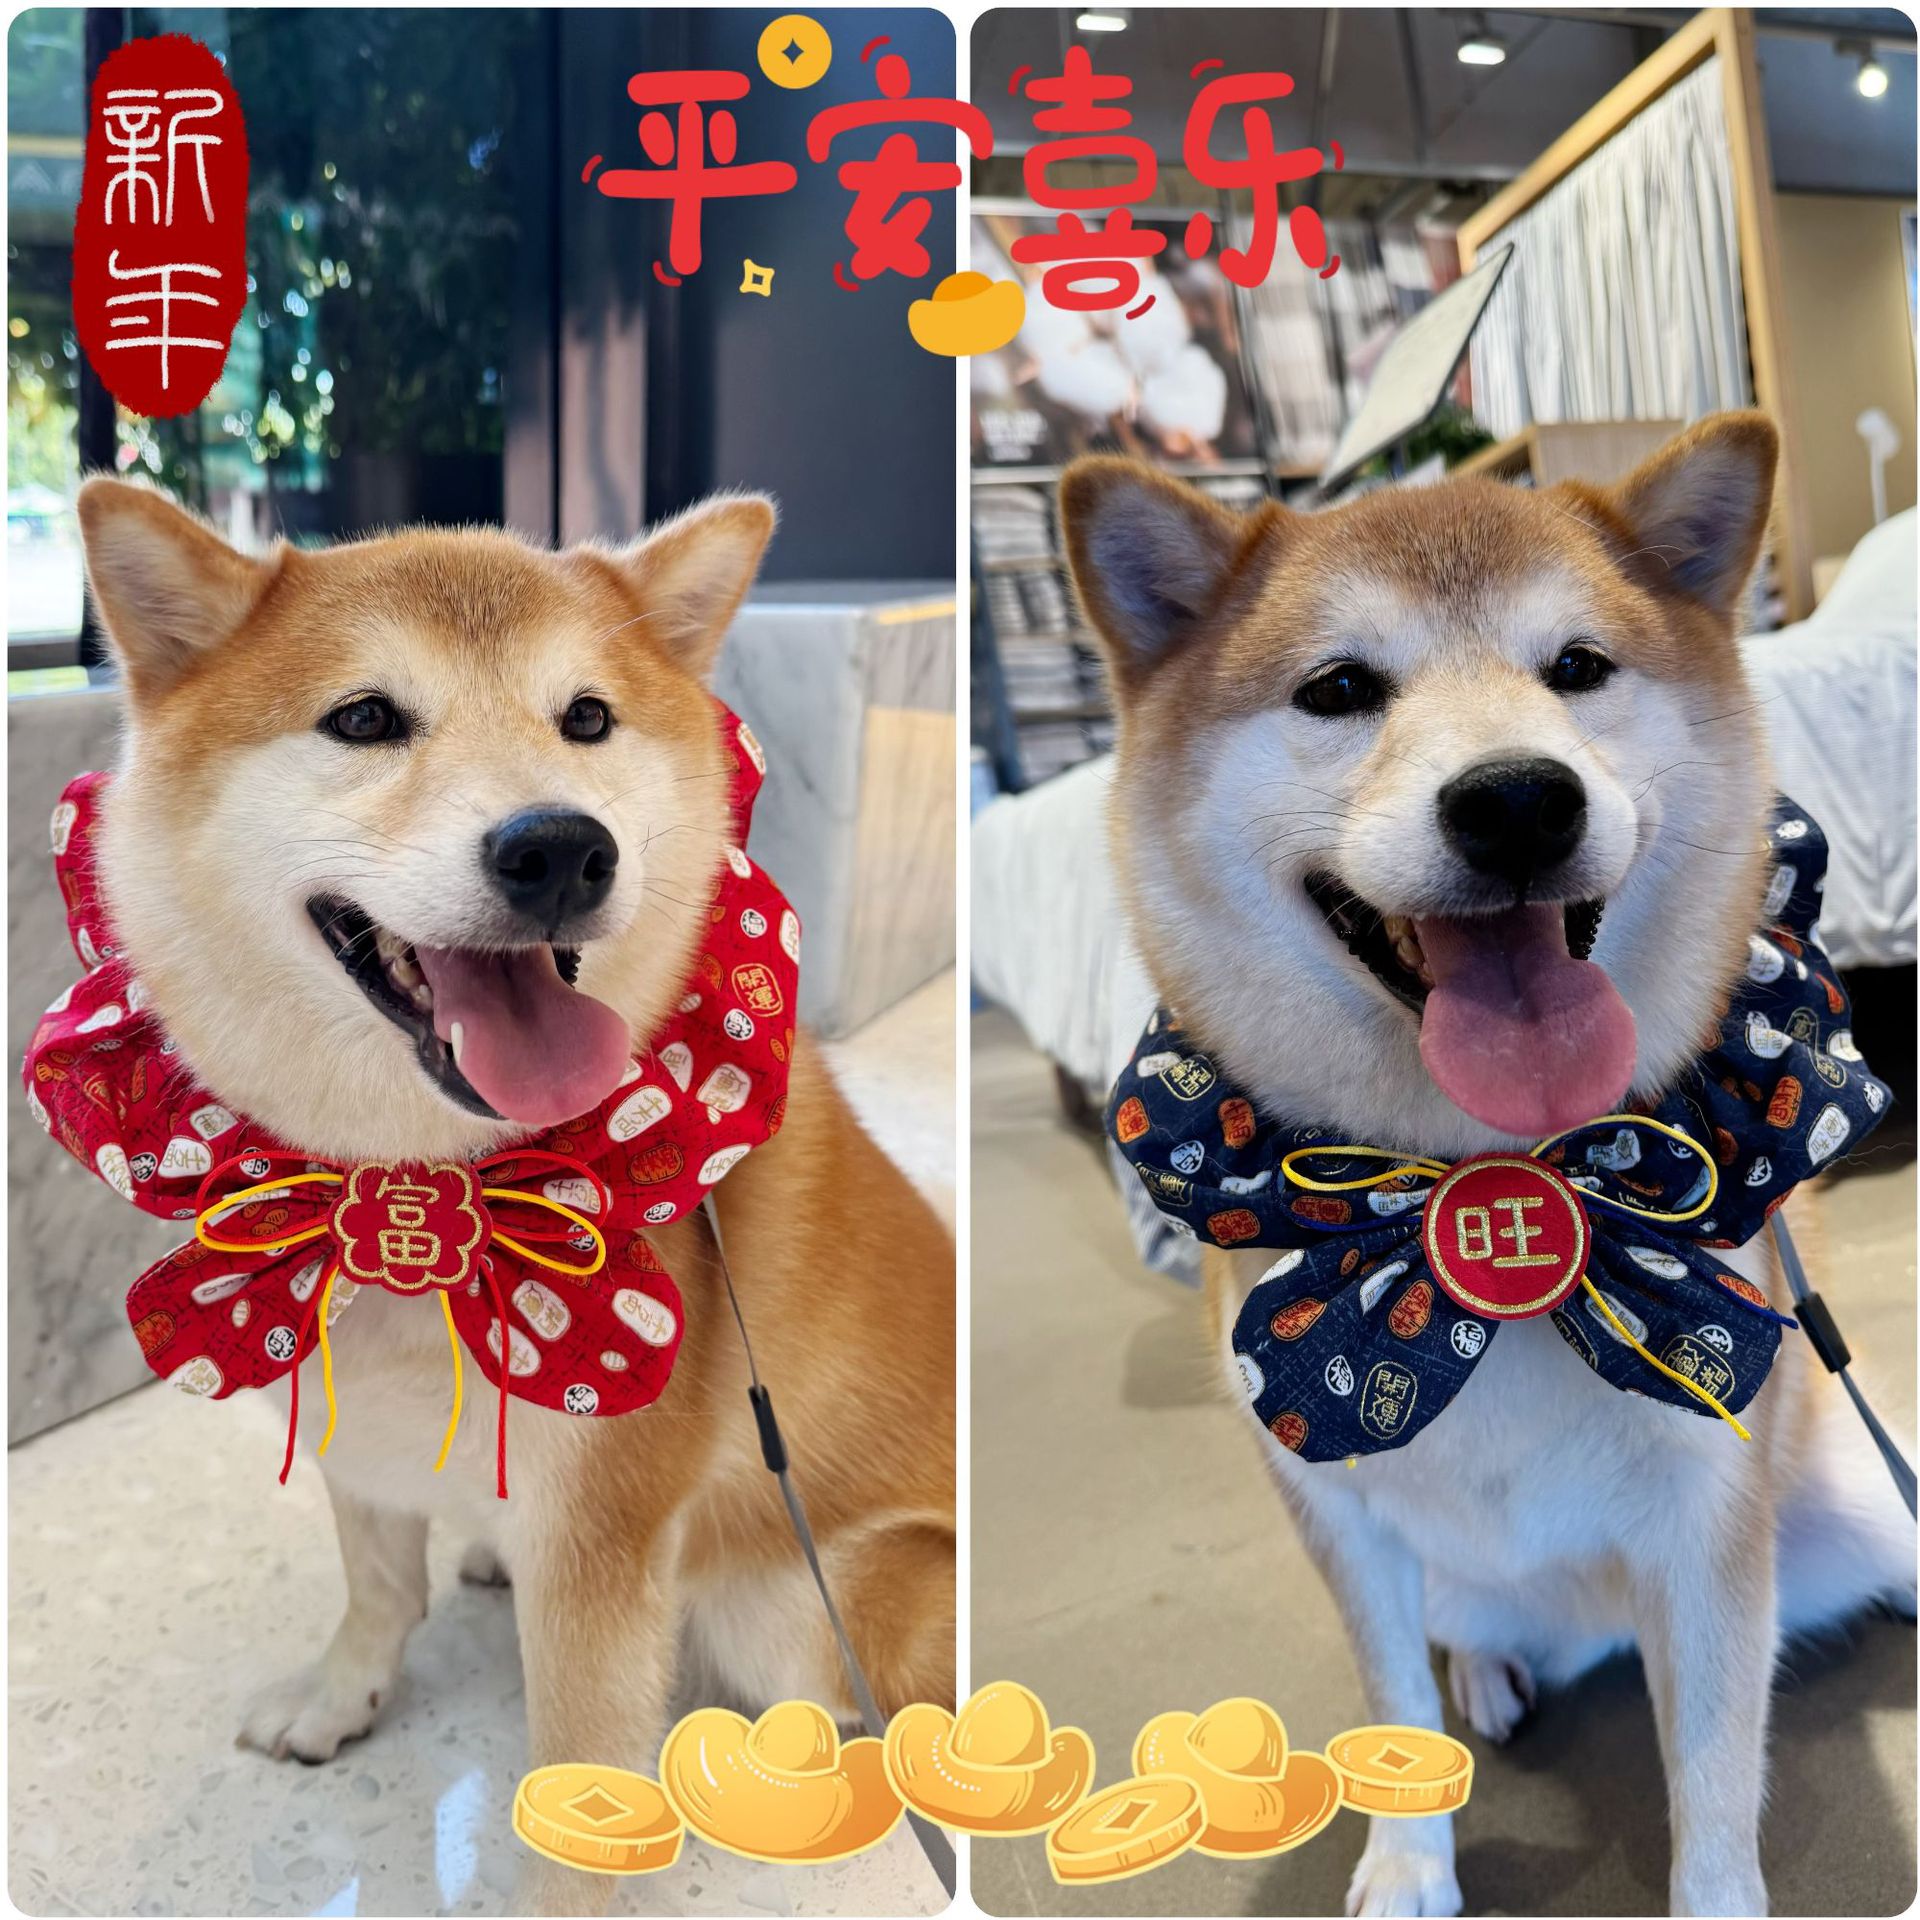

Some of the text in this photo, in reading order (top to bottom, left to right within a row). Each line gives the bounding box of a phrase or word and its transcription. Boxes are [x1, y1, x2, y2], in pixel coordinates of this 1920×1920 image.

[736, 967, 776, 1010] 開運
[375, 1172, 442, 1266] 富
[1454, 1196, 1561, 1269] 旺
[267, 1328, 297, 1360] 福
[1453, 1322, 1484, 1357] 福
[1327, 1357, 1353, 1394] 福
[566, 1385, 597, 1414] 福
[1366, 1369, 1411, 1433] 開運
